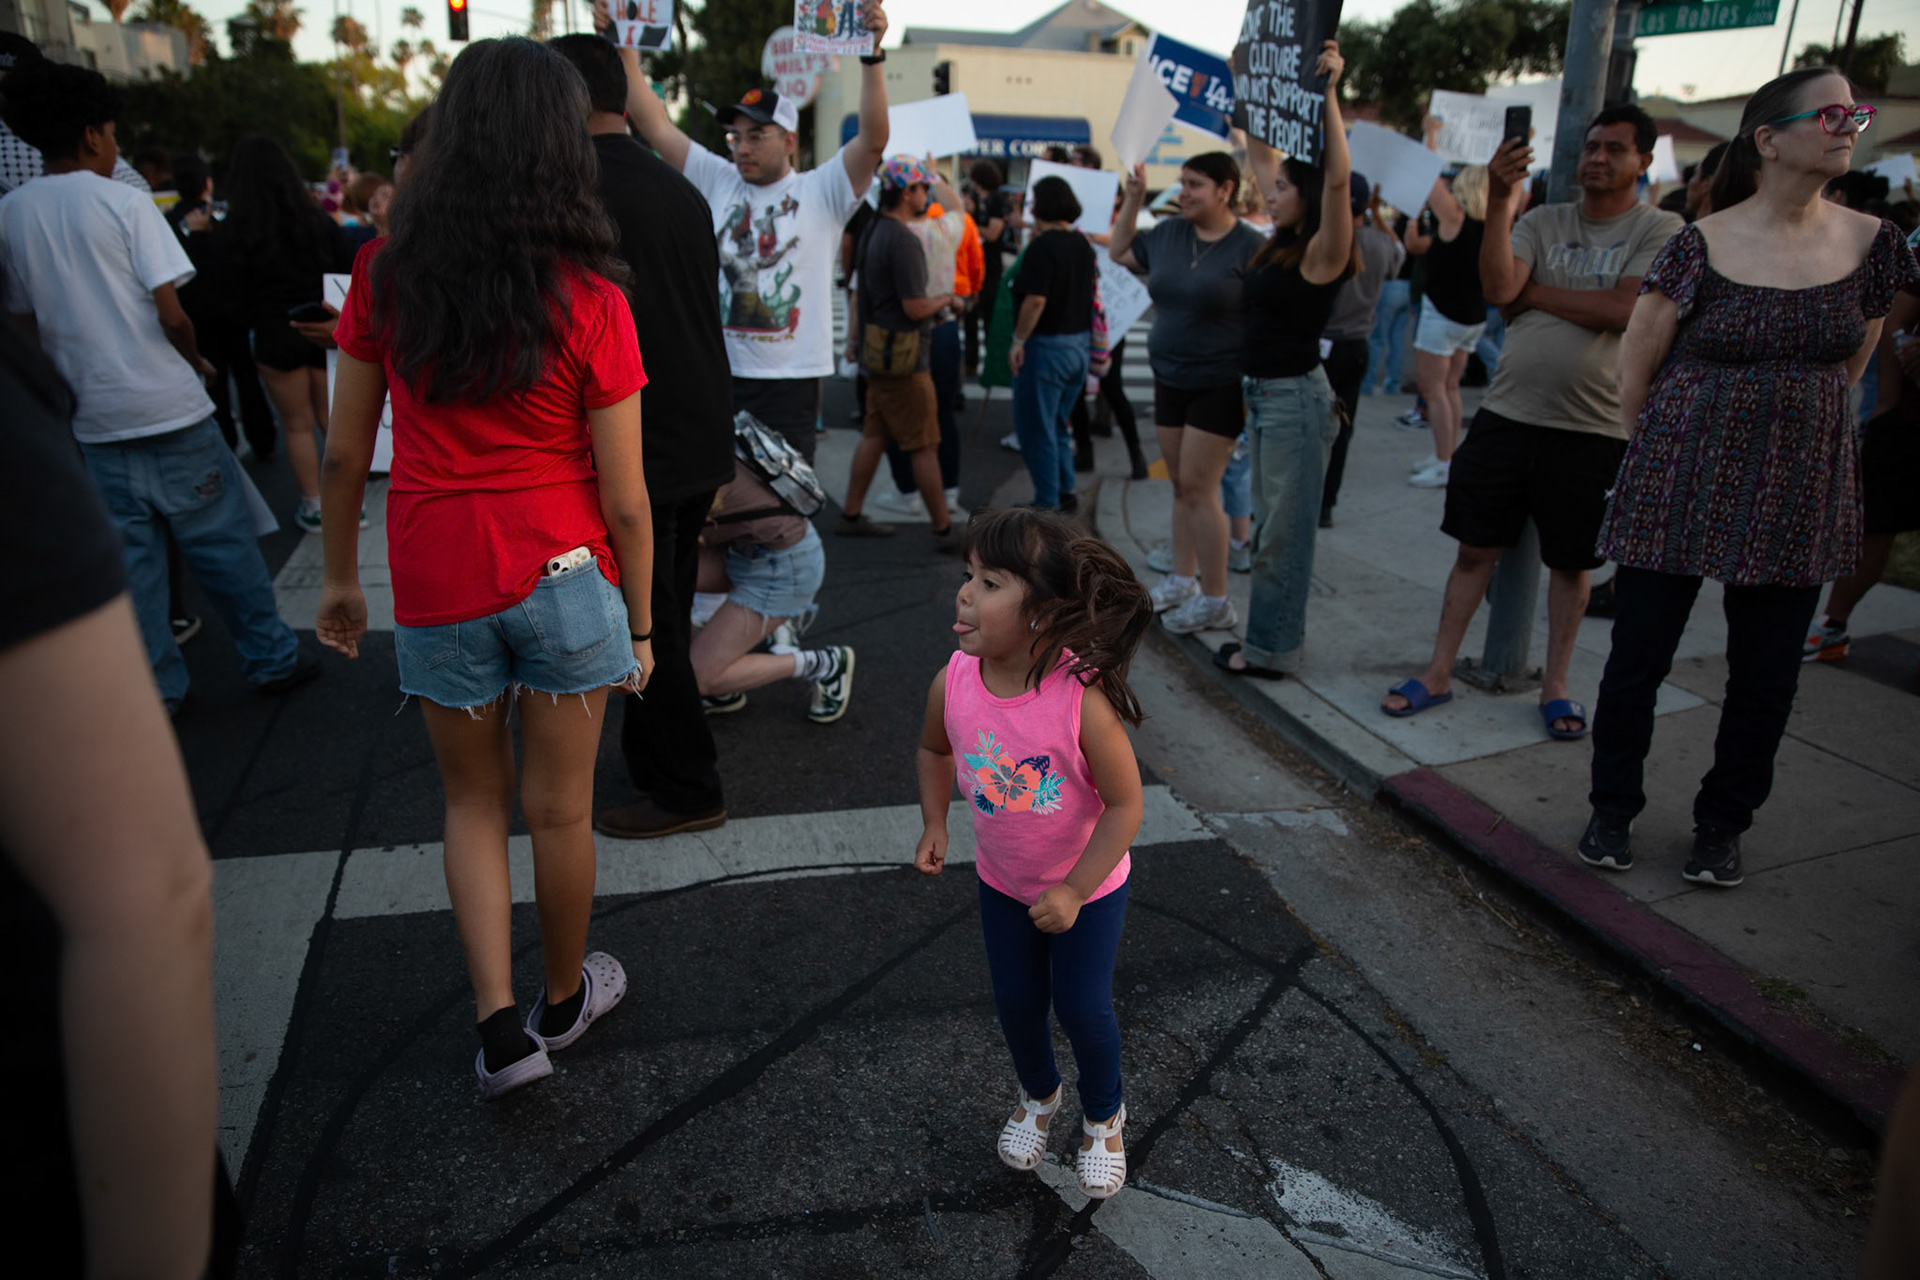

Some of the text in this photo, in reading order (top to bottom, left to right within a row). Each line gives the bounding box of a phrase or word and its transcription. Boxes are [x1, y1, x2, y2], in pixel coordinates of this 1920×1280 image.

[1268, 1, 1295, 38] THE
[1636, 3, 1740, 34] Los Robles
[1150, 53, 1194, 95] ICE
[1248, 41, 1302, 80] CULTURE
[1250, 75, 1269, 107] NOT
[1270, 76, 1325, 126] SUPPORT
[1245, 103, 1315, 165] THE PEOPLE
